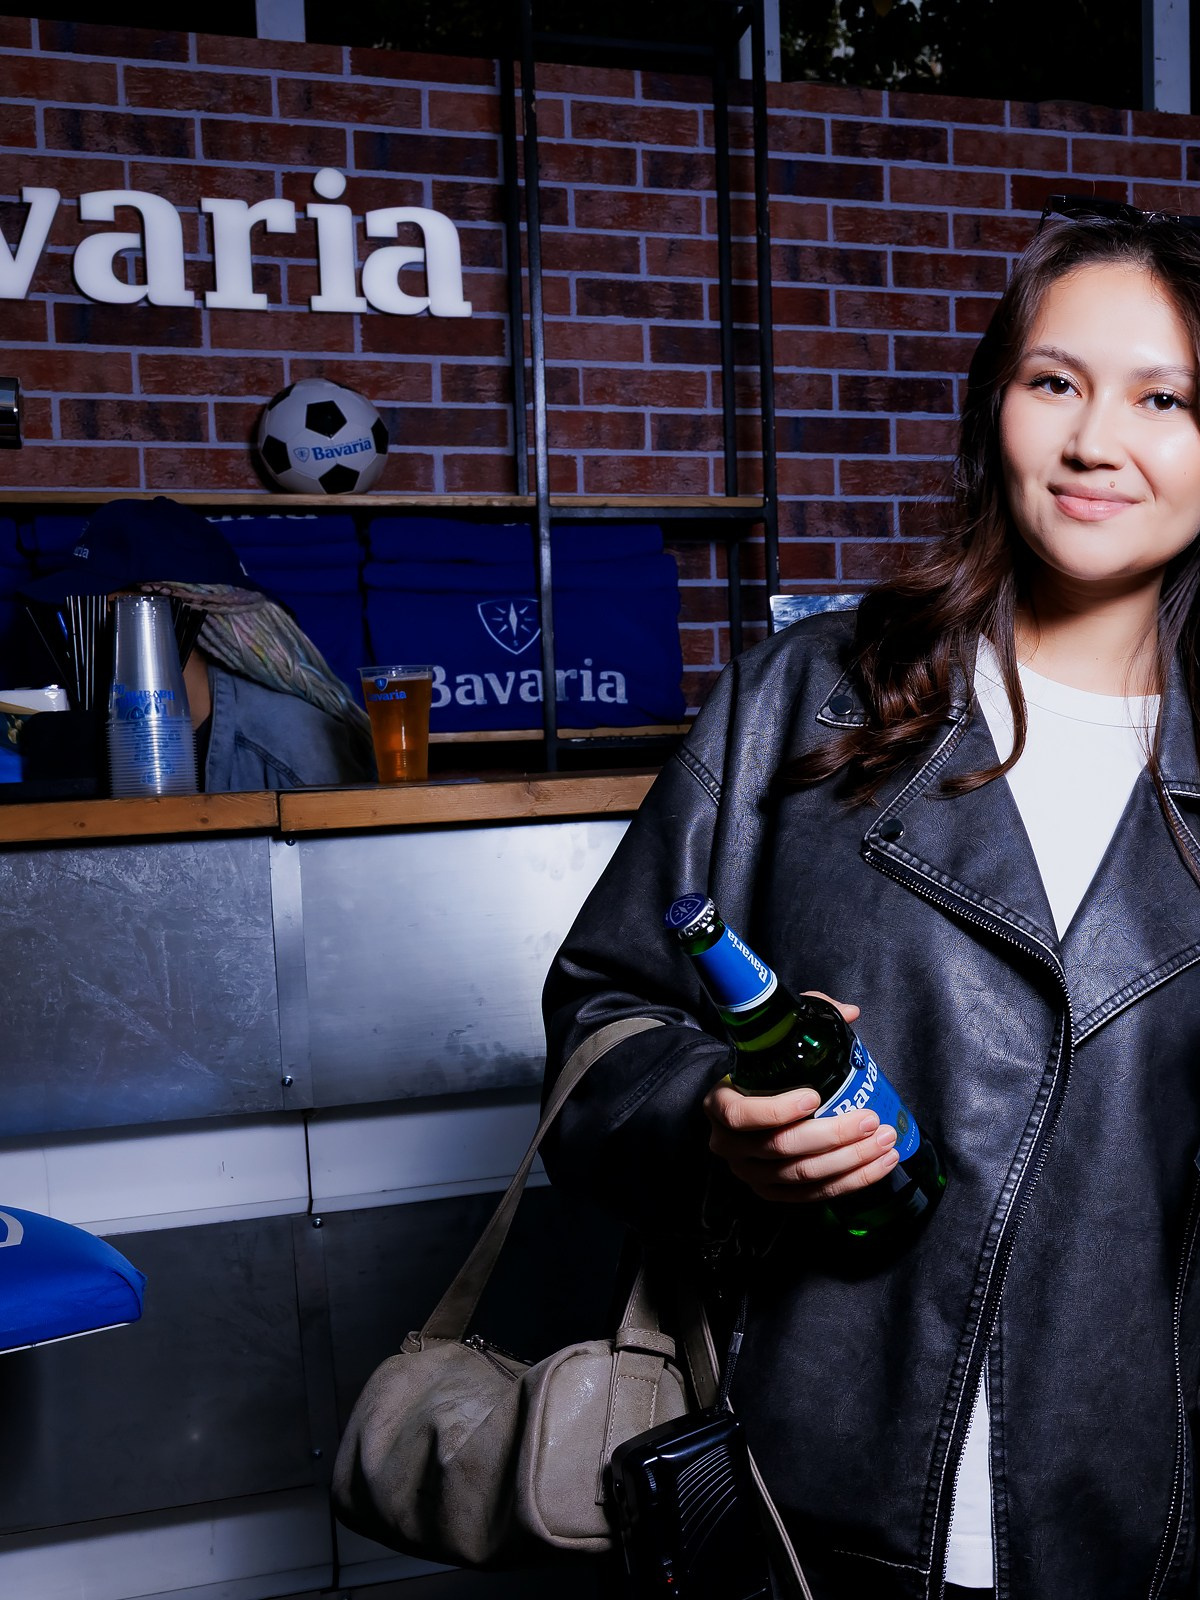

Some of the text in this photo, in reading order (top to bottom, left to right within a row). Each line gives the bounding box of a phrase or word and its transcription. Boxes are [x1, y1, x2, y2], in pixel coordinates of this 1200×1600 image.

[311, 438, 372, 461] Bavaria
[368, 689, 407, 702] avaria
[727, 928, 769, 984] Bavaria
